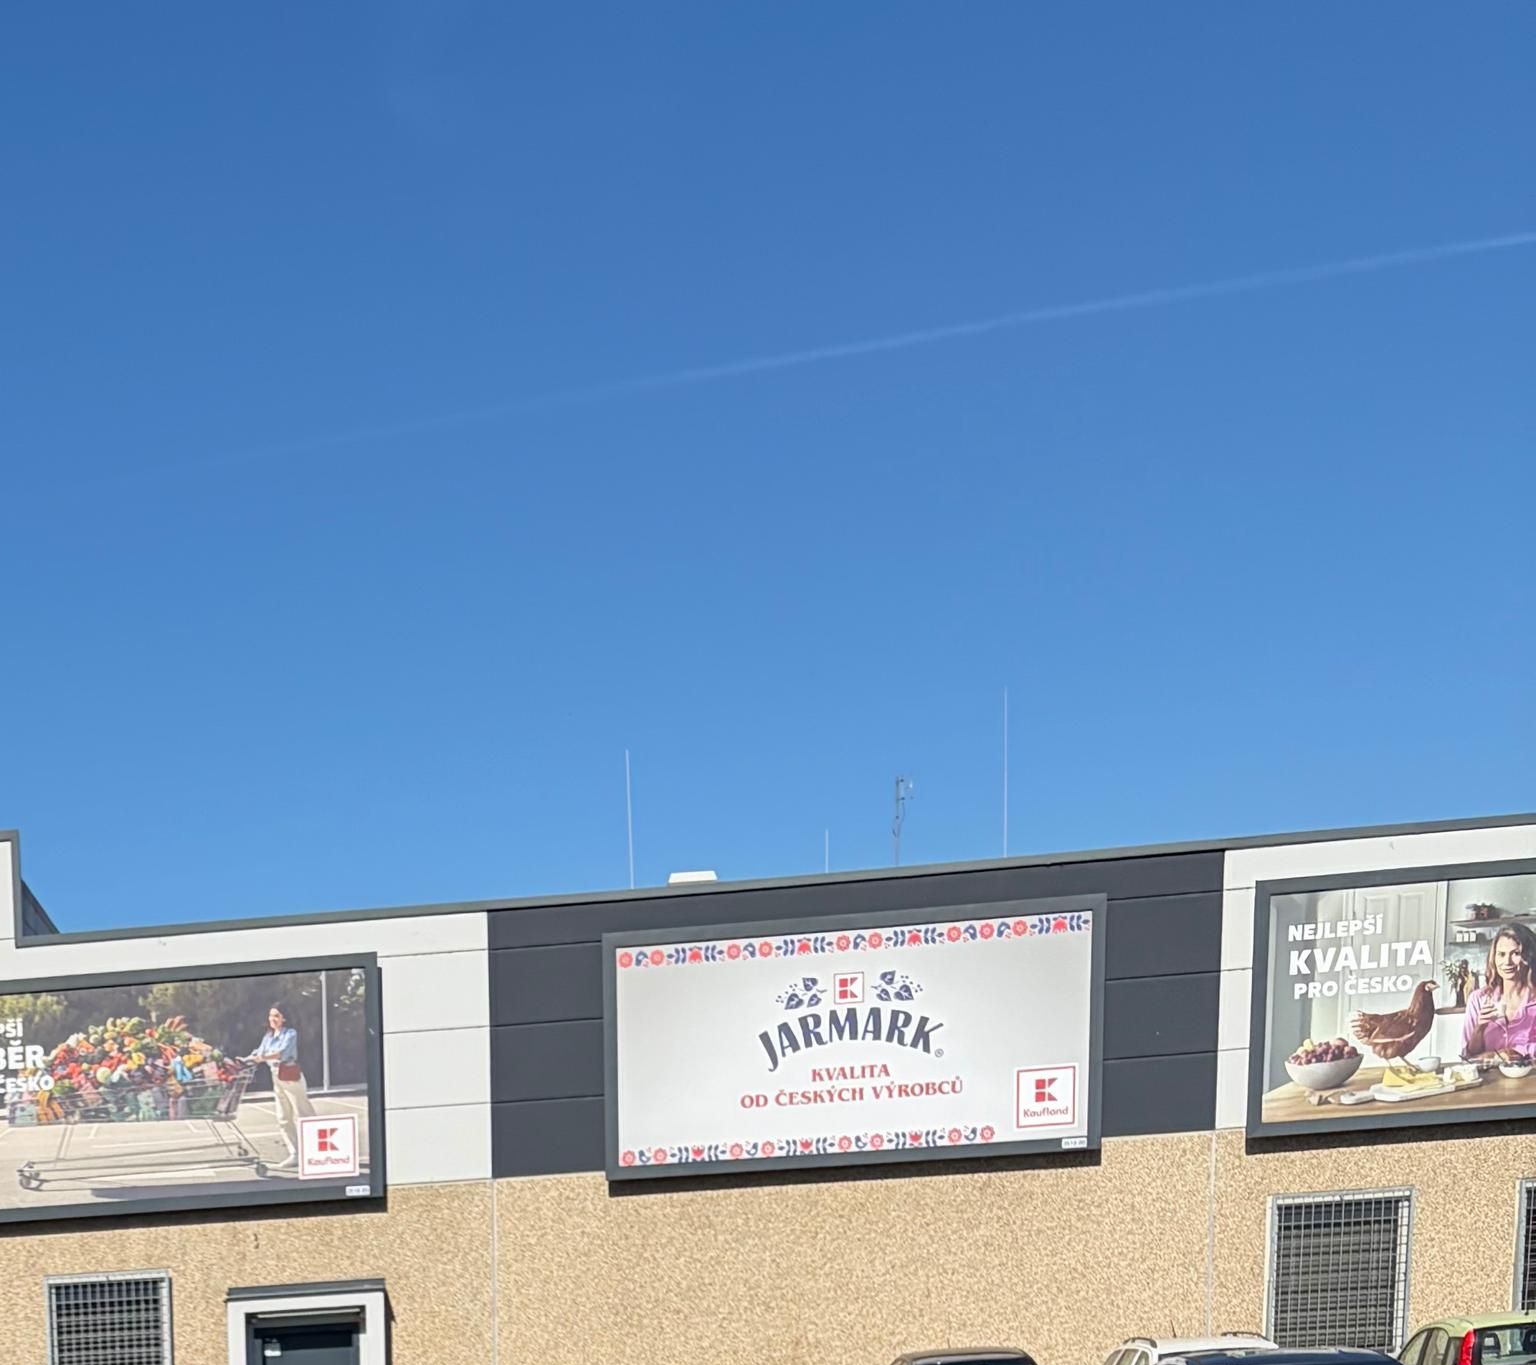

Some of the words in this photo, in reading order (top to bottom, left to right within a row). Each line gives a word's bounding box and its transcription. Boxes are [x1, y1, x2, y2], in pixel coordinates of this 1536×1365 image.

[1287, 912, 1384, 942] NEJLEPŠÍ
[1288, 939, 1433, 976] KVALITA
[1293, 981, 1339, 1000] PRO
[1343, 974, 1413, 996] ČESKO
[758, 1006, 945, 1073] JARMARK
[811, 1064, 891, 1083] KVALITA
[740, 1093, 769, 1109] OD
[774, 1085, 865, 1107] ČESKÝCH
[870, 1076, 964, 1099] VÝROBCŮ
[1023, 1105, 1070, 1118] Kaufland
